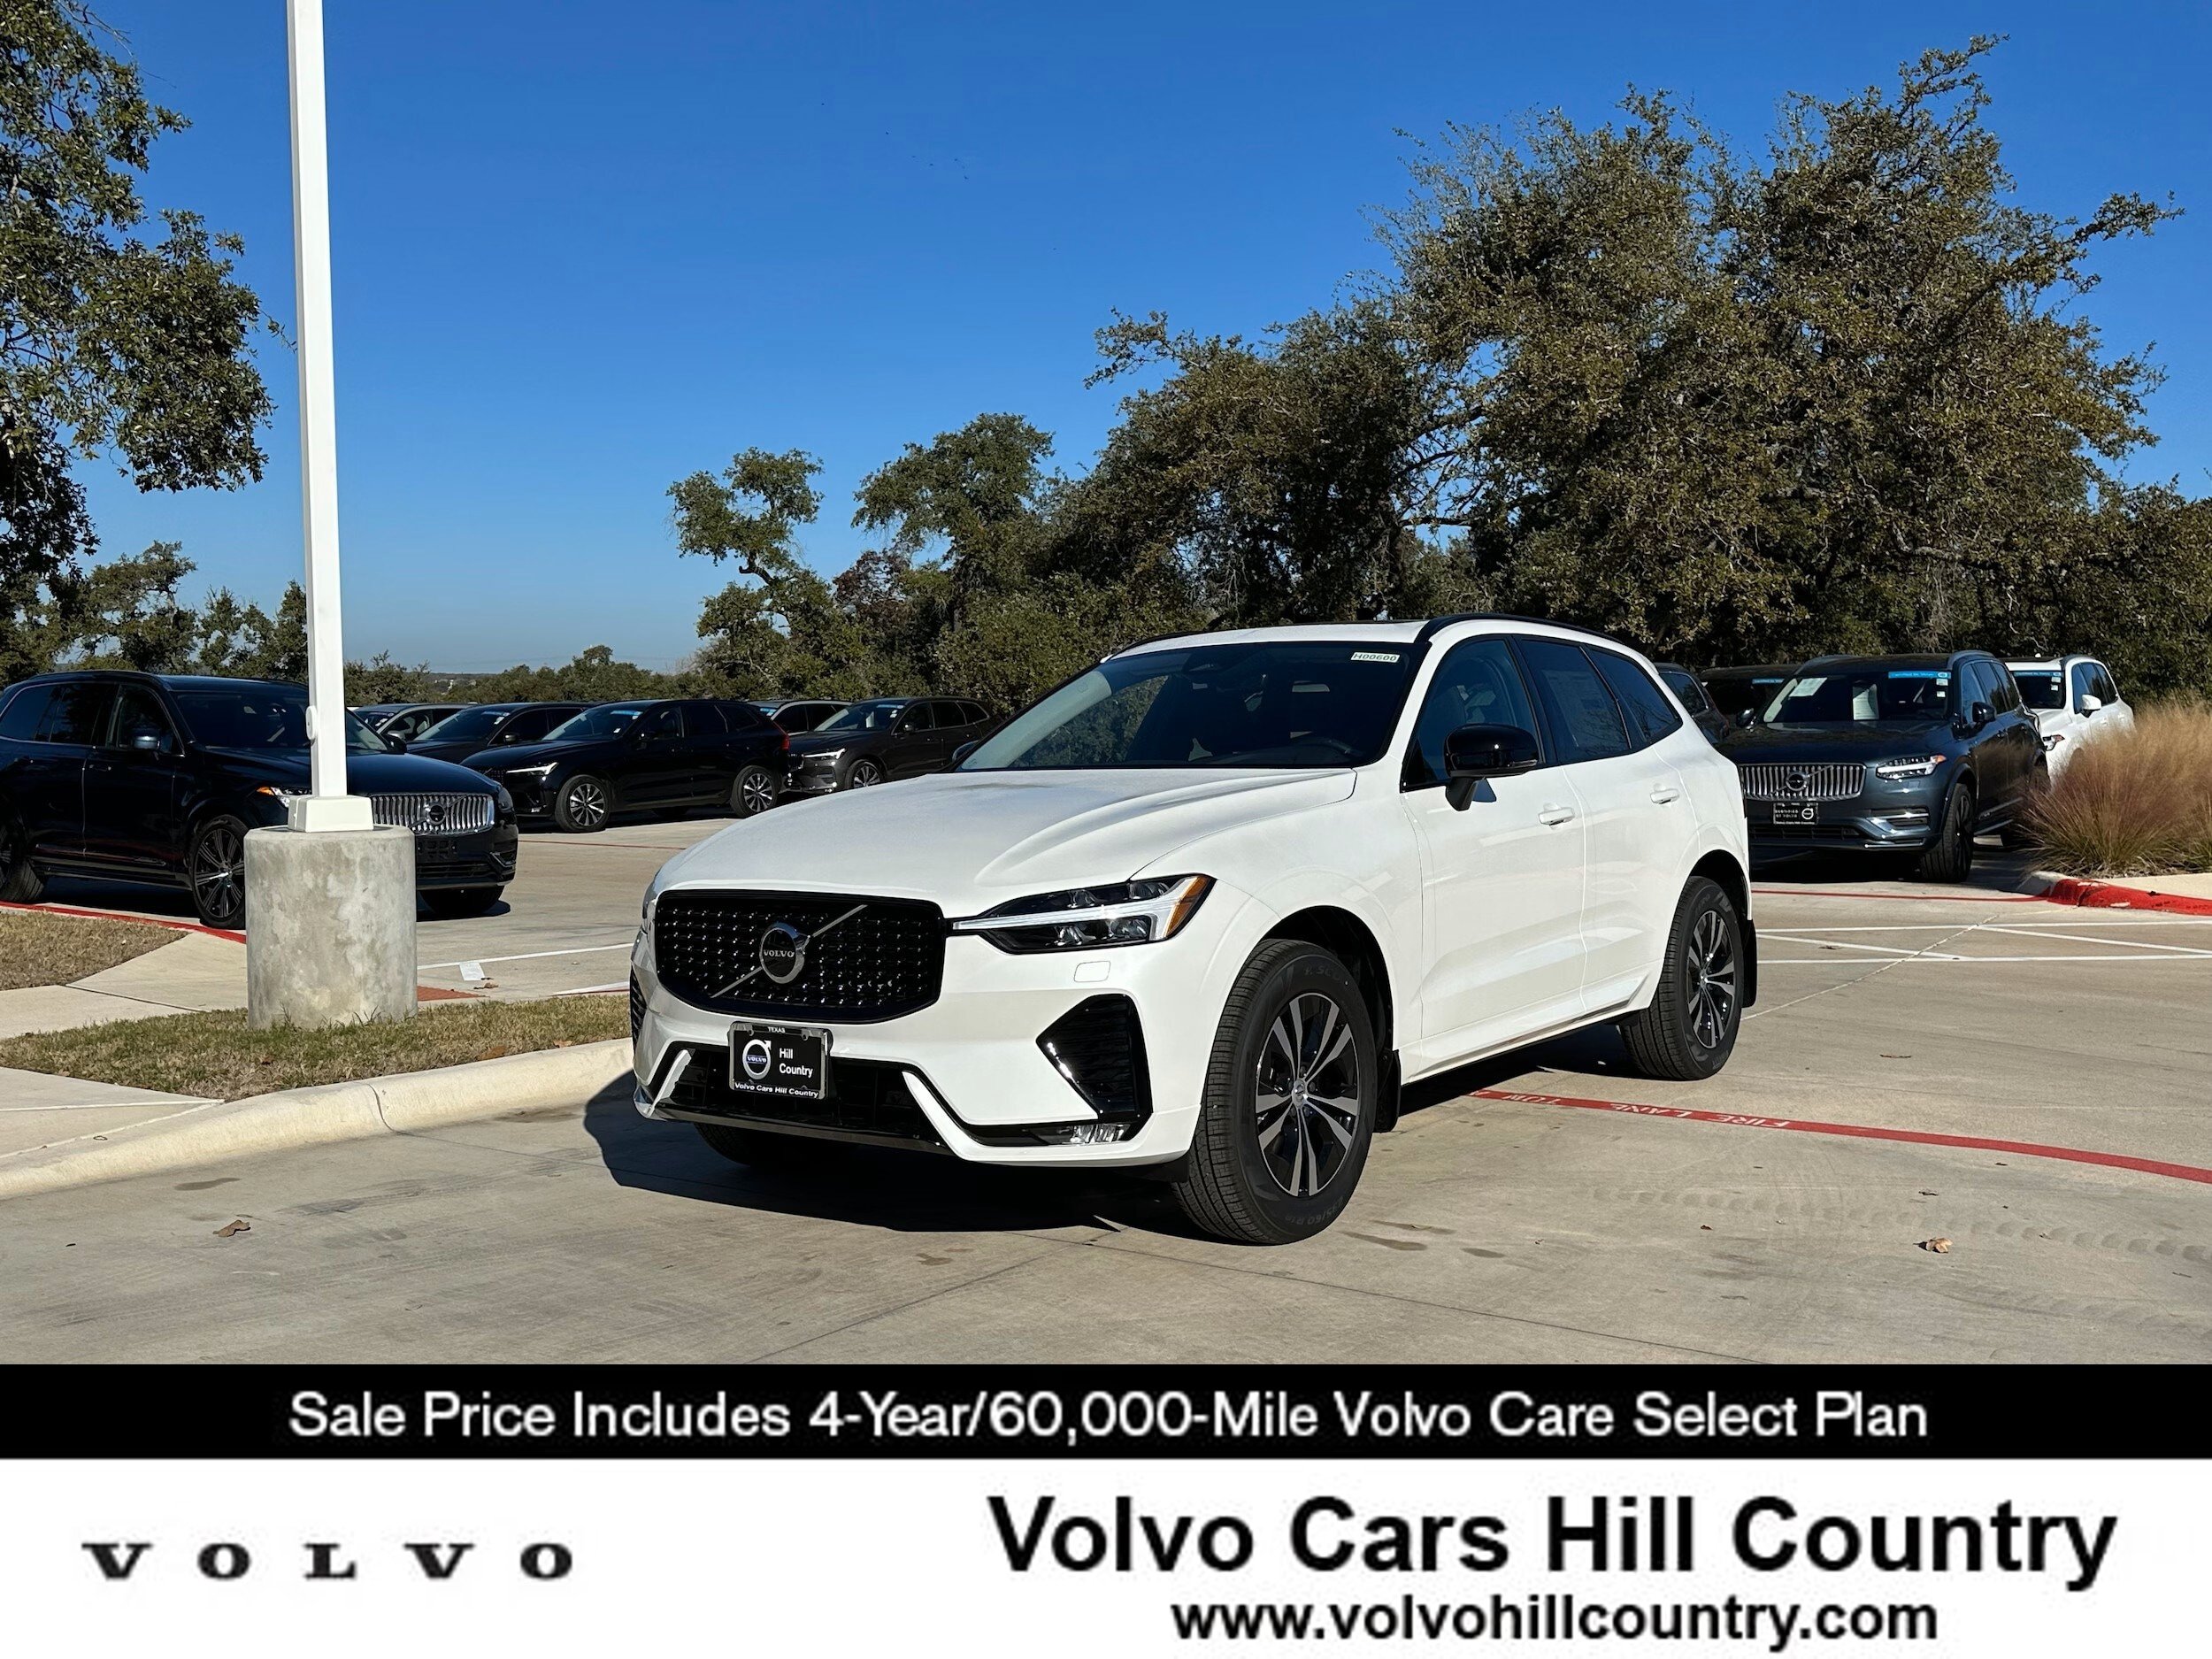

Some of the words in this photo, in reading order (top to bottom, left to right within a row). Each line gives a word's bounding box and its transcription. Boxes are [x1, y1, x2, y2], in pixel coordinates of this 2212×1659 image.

[763, 949, 795, 957] VOLVO
[779, 1048, 794, 1059] Hill
[779, 1063, 813, 1079] Country
[734, 1081, 755, 1091] Volvo
[756, 1084, 773, 1093] Cars
[788, 1088, 819, 1098] Country
[1609, 1102, 1694, 1118] LANE
[1708, 1114, 1790, 1128] FIRE
